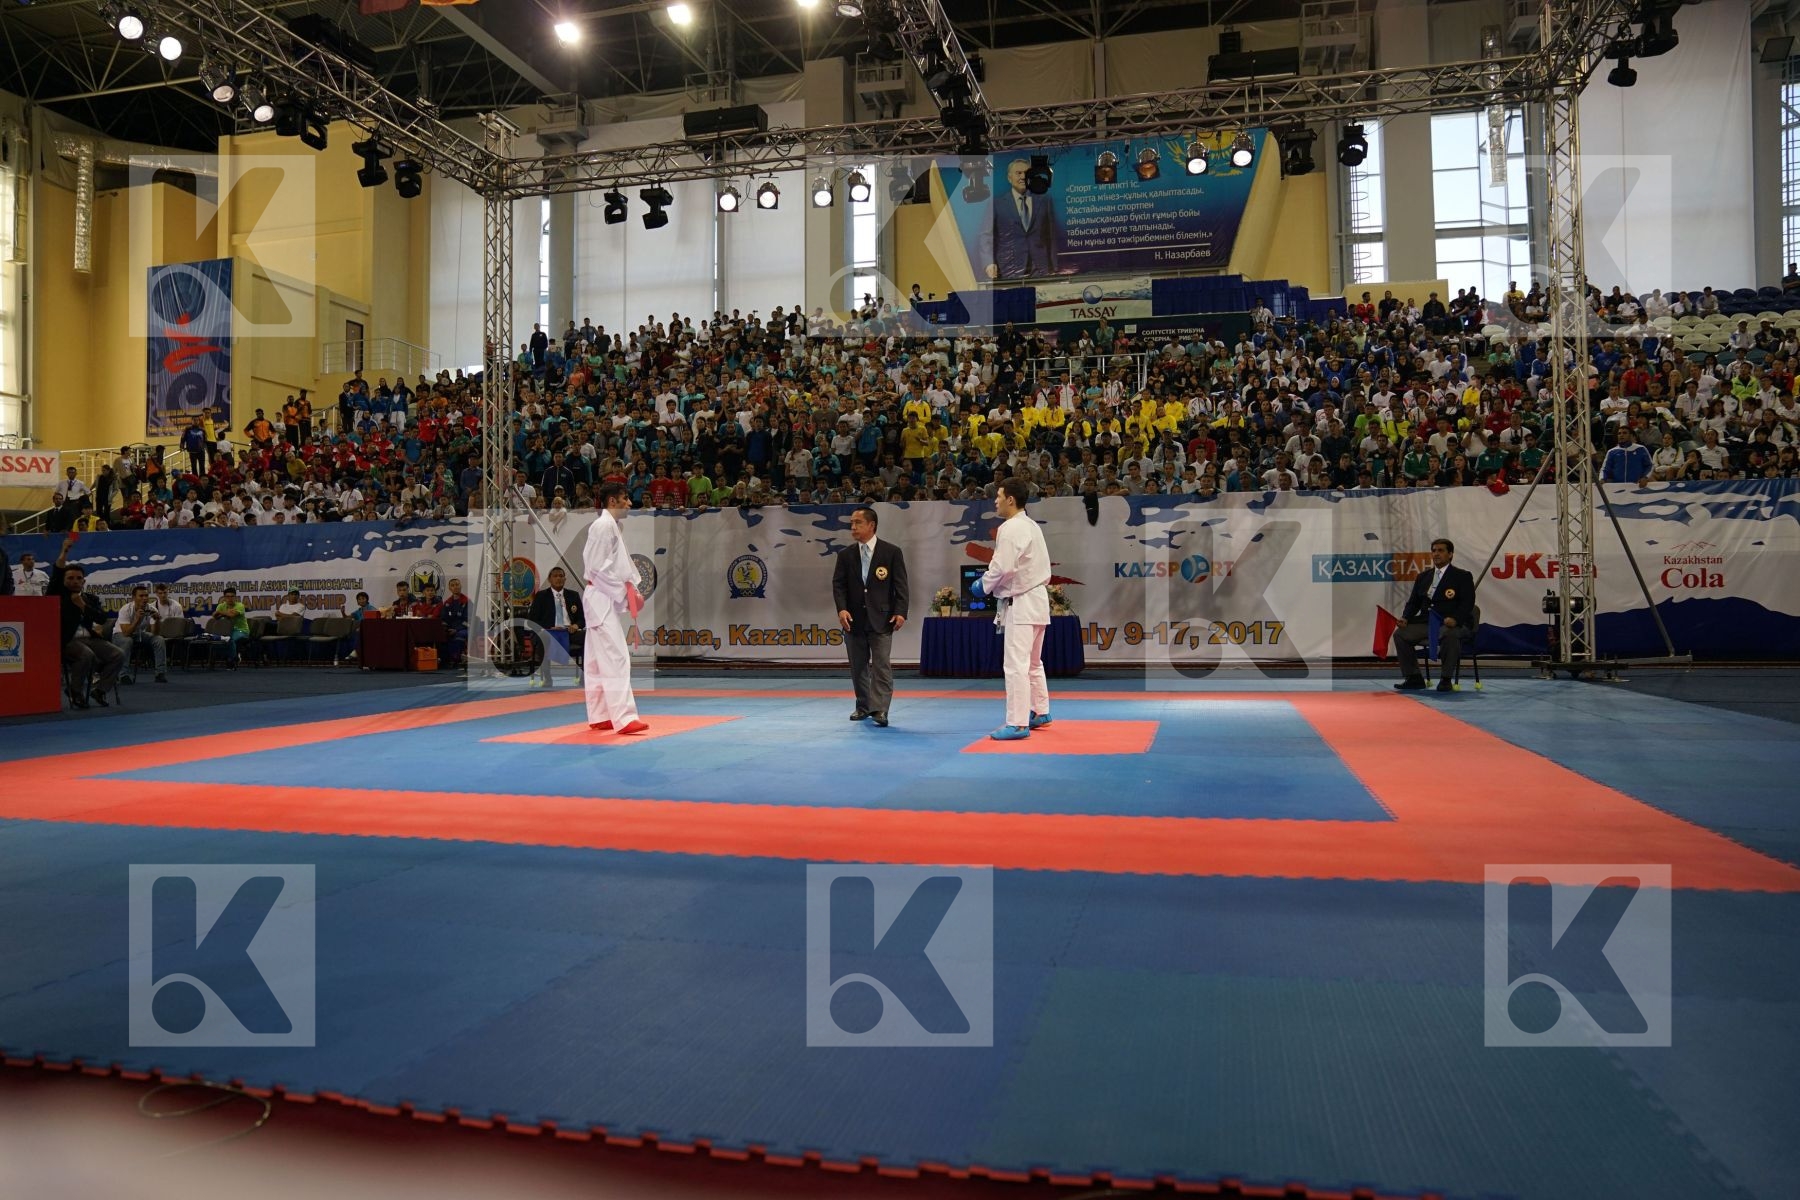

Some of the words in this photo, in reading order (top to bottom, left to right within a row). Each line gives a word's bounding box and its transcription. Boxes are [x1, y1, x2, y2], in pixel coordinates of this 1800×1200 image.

[1065, 194, 1096, 204] Спортта
[1066, 204, 1116, 215] Жастайынан
[1117, 201, 1154, 212] спортпен
[1178, 208, 1200, 218] бойы
[1100, 224, 1128, 235] жетуге
[1066, 238, 1083, 248] Мен
[1154, 251, 1163, 261] Н.
[1164, 248, 1211, 261] Назарбаев
[1070, 306, 1118, 319] TASSAY
[0, 455, 56, 473] SSAY
[1663, 556, 1723, 565] Kazakhstan
[1660, 567, 1725, 589] Cola
[260, 580, 287, 592] АЗИЯ
[626, 624, 721, 650] Astana,
[729, 624, 846, 646] Kazakhs
[1124, 622, 1200, 650] 9-17,
[1208, 621, 1286, 645] 2017
